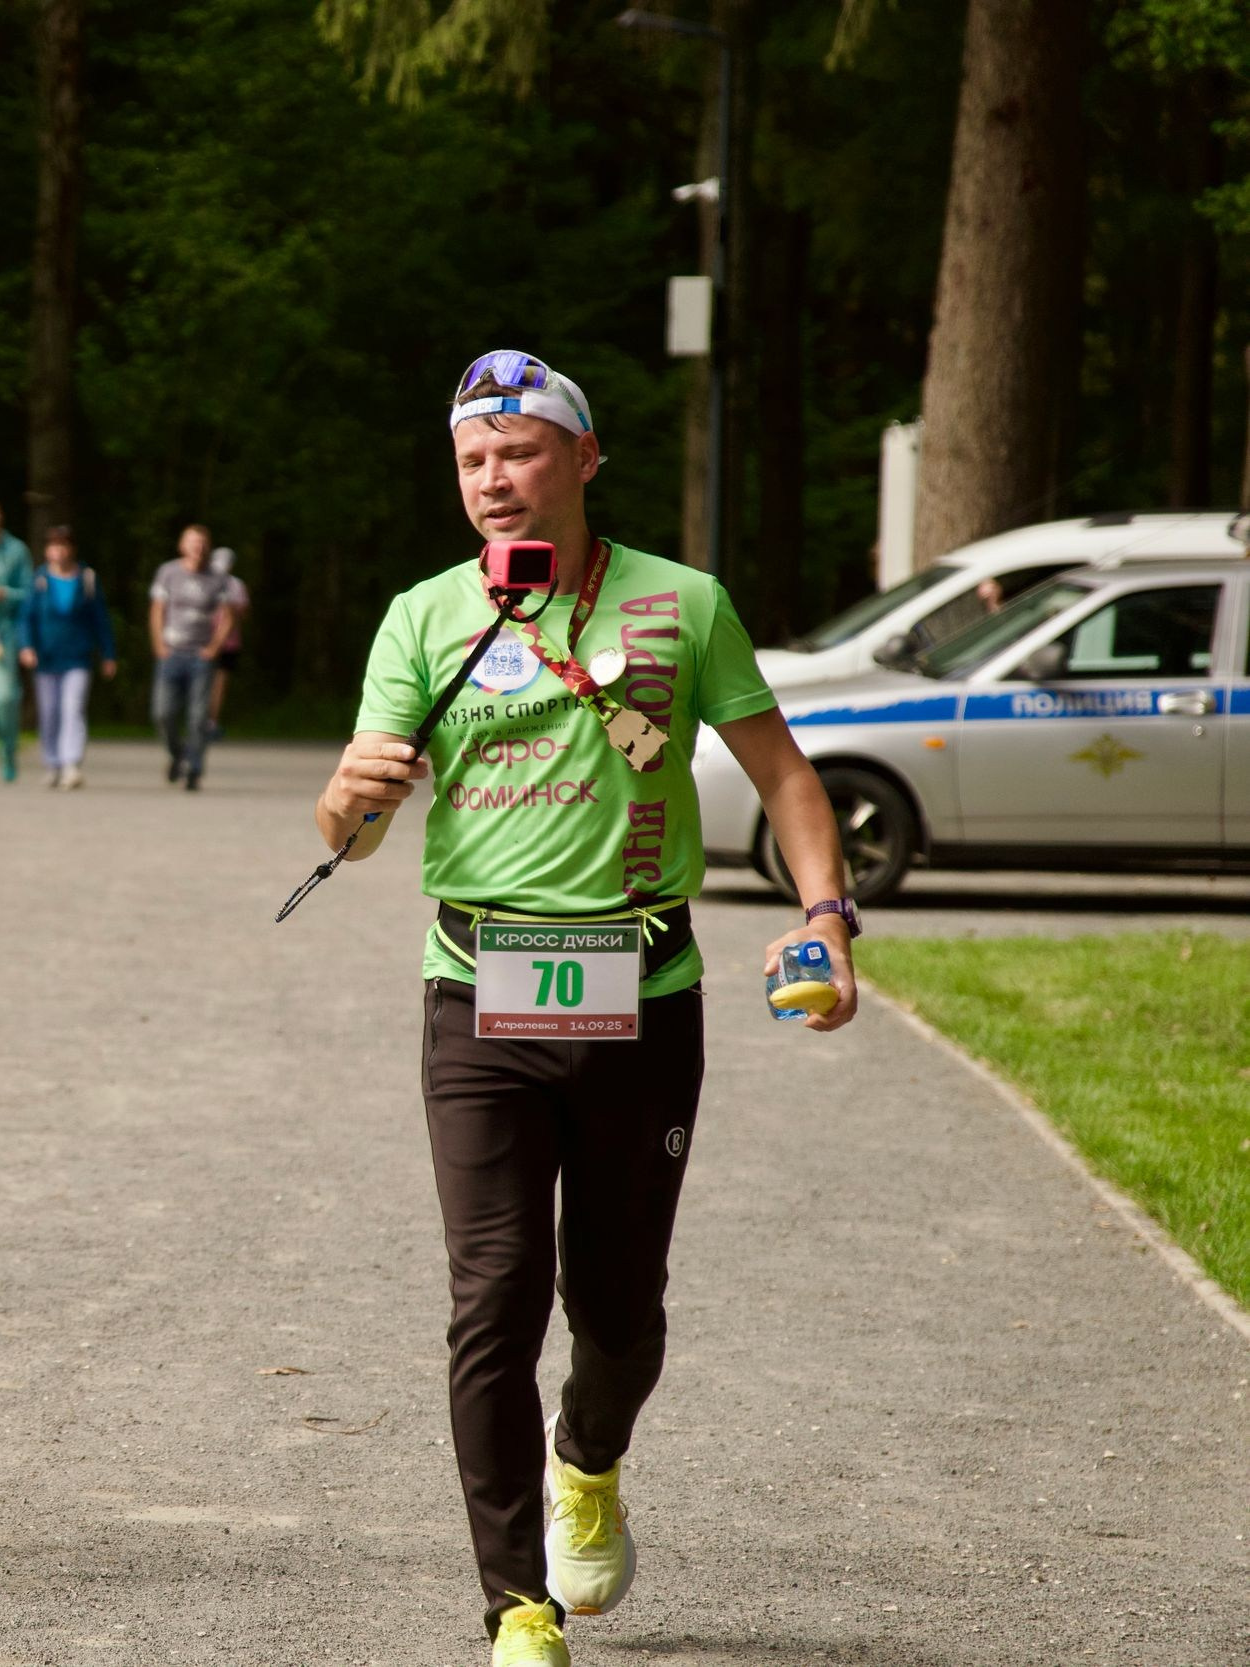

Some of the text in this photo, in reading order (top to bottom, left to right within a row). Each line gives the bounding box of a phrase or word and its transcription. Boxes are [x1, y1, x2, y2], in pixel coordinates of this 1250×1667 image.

[442, 696, 586, 728] КУЗНЯ СПОРТА
[495, 933, 623, 949] КРОСС ДУБКИ
[532, 960, 584, 1008] 70
[494, 1020, 623, 1031] Апрелевка 14.09.25
